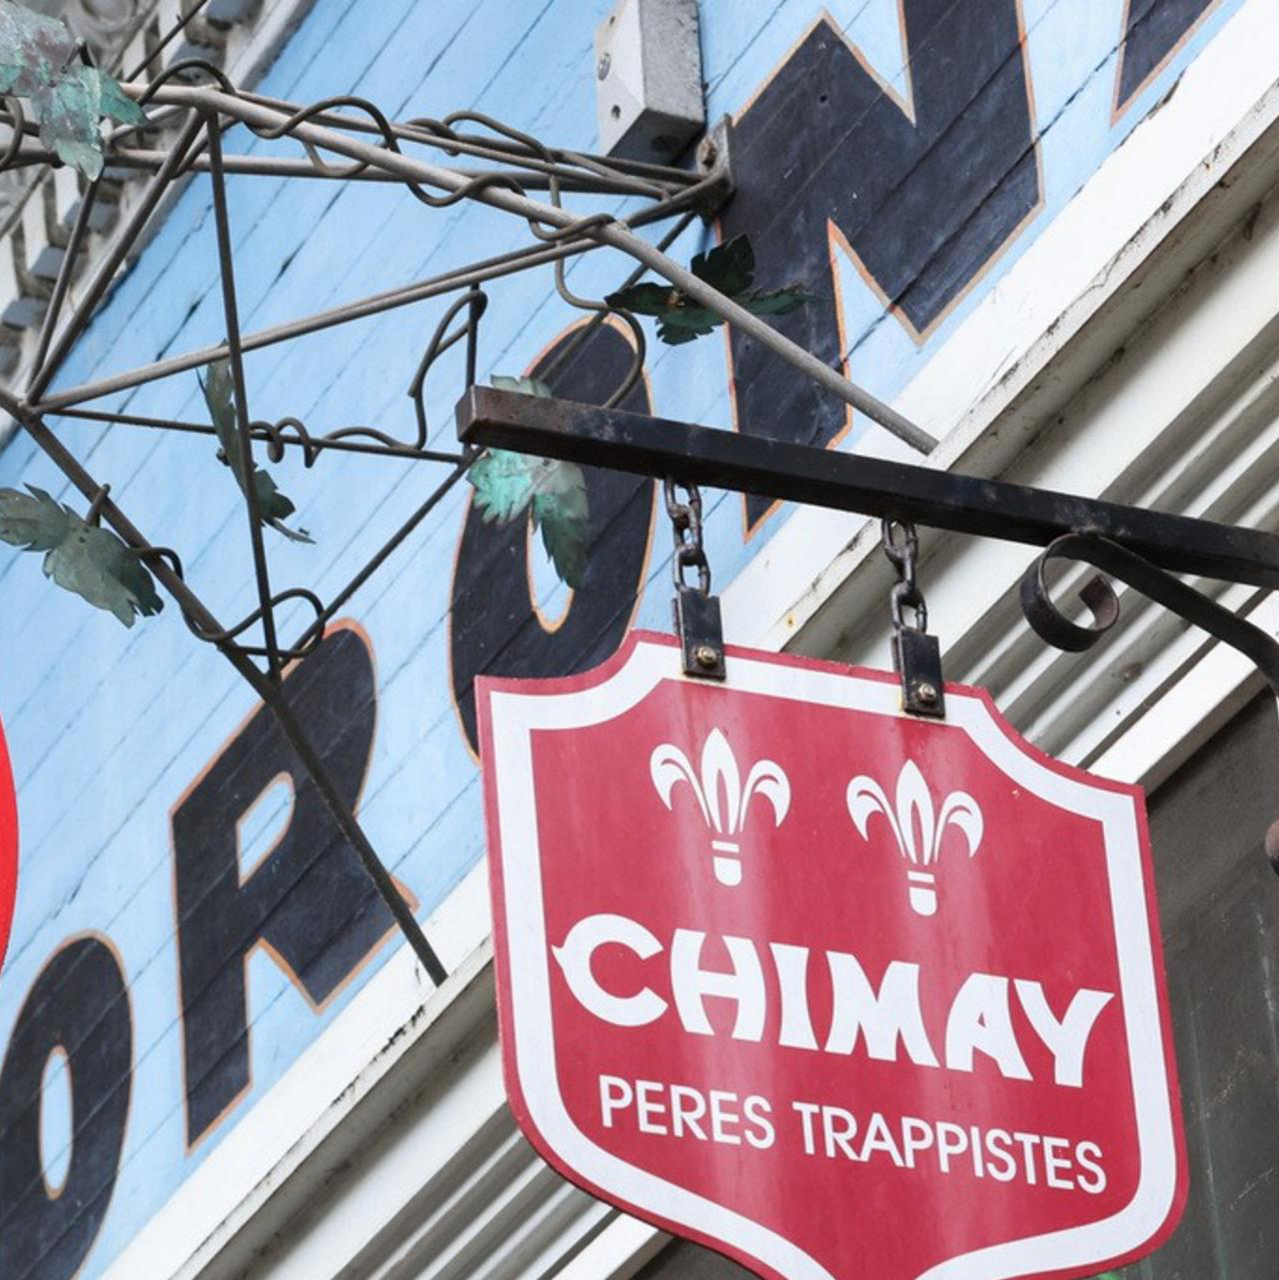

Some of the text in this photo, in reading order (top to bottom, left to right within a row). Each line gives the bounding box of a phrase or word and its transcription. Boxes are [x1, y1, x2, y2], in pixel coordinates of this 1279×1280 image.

[551, 912, 1116, 1088] CHIMAY
[599, 1074, 1107, 1194] PERES TRAPPISTES
